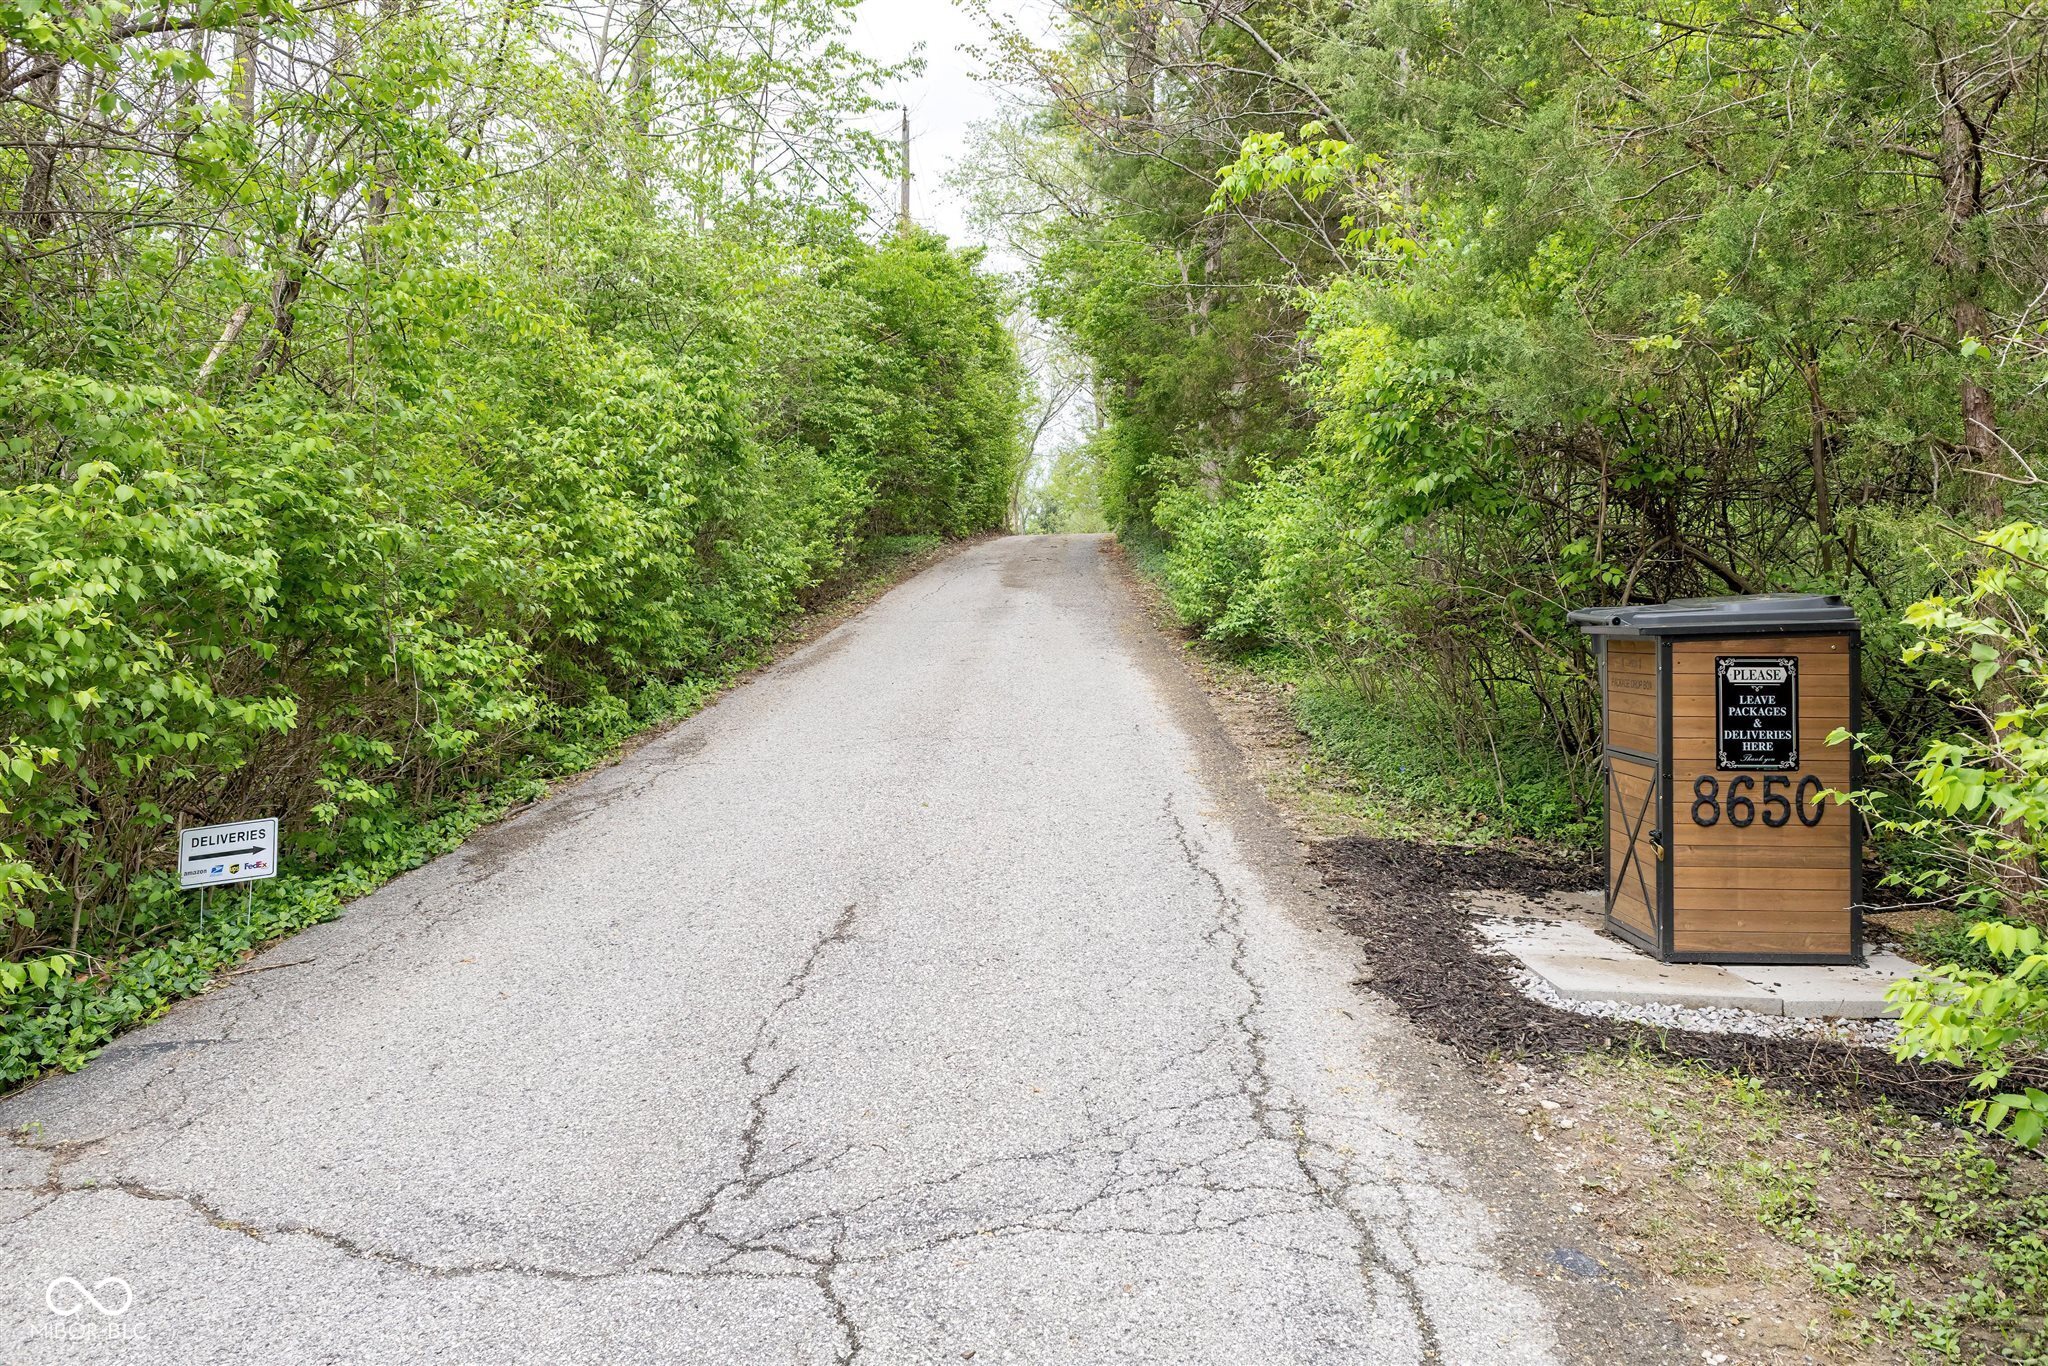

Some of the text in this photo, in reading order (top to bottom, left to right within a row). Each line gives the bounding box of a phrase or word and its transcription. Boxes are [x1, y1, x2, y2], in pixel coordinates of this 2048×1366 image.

[1733, 669, 1782, 681] PLEASE
[1739, 695, 1776, 705] LEAVE
[1728, 706, 1787, 717] PACKAGES
[1753, 718, 1762, 728] &
[1724, 730, 1792, 740] DELIVERIES
[1742, 742, 1774, 751] HERE
[1740, 753, 1776, 765] Thank you
[1691, 774, 1825, 828] 8650
[191, 828, 266, 848] DELIVERIES
[183, 869, 208, 877] amazon
[244, 860, 268, 870] FedEx
